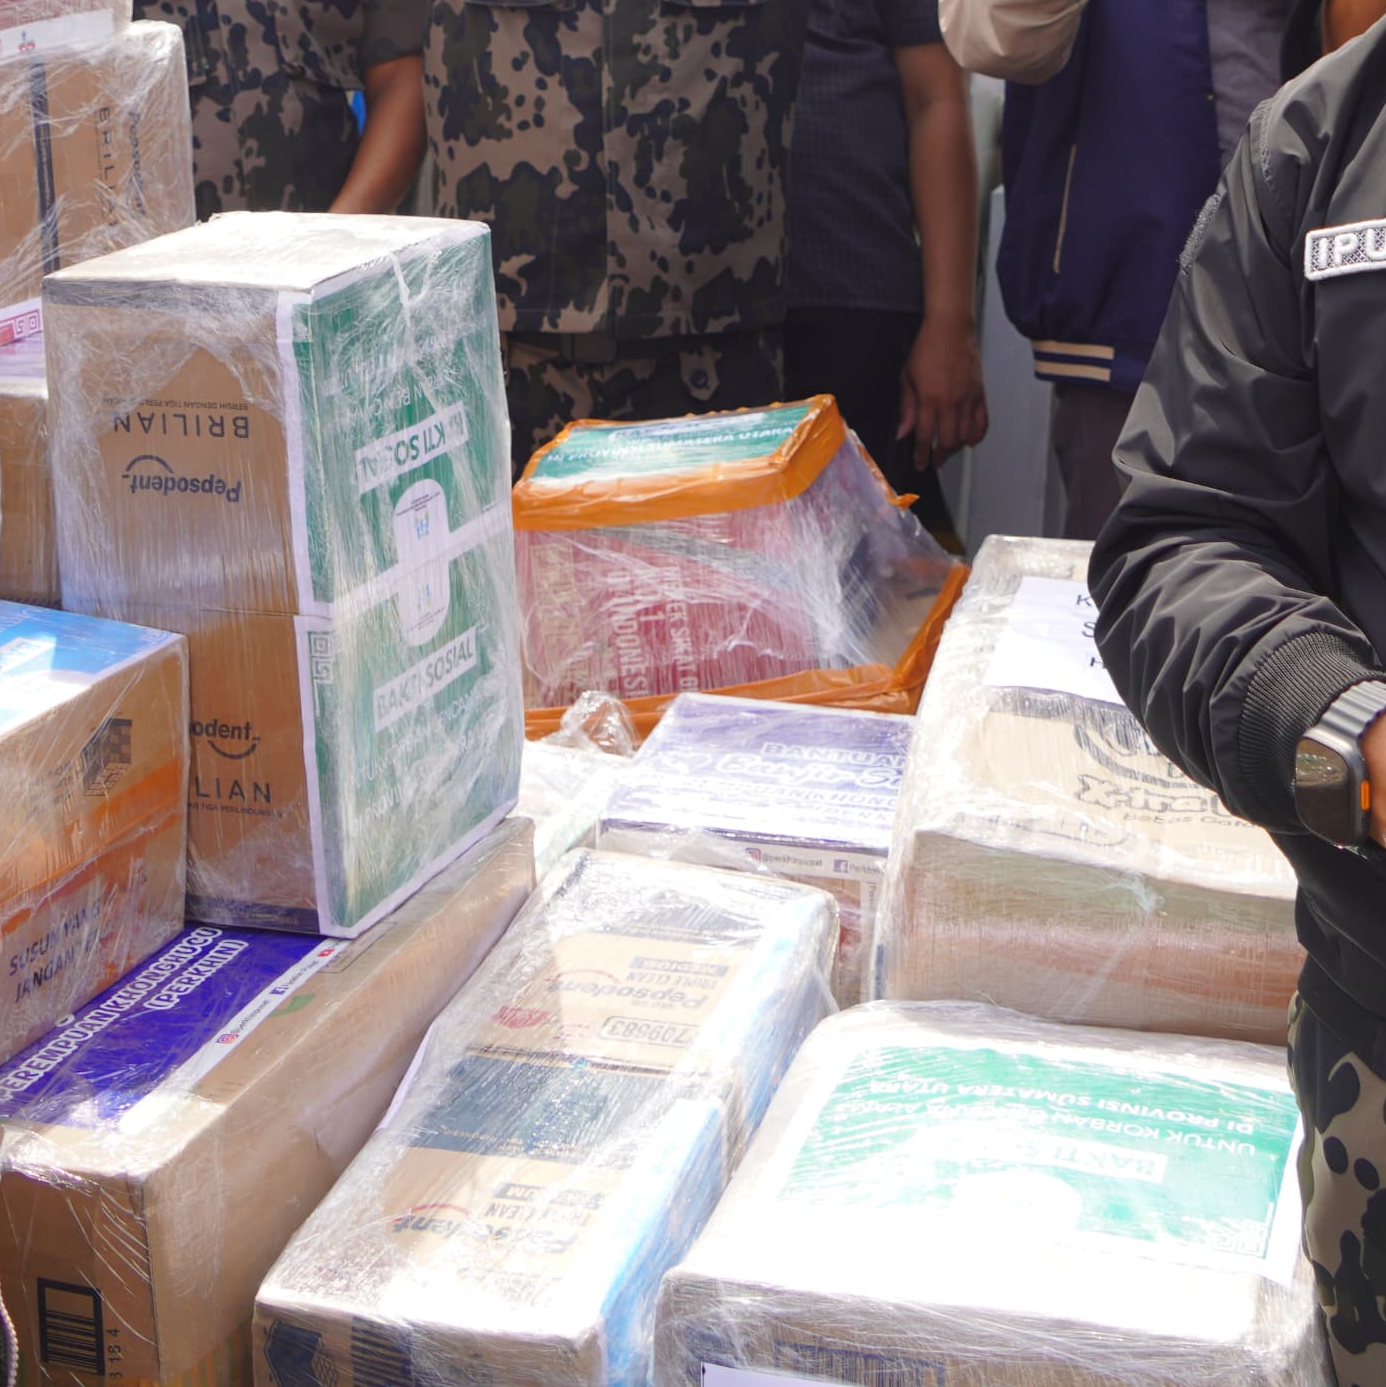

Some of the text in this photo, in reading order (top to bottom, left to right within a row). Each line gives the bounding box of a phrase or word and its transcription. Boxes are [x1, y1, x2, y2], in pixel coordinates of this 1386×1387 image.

[185, 401, 218, 410] DENGAN
[219, 401, 249, 411] BERSIH
[113, 412, 250, 439] BRILIAN
[130, 473, 243, 503] Pepsodent
[425, 635, 475, 689] SOSIAL
[195, 775, 272, 804] LIAN
[103, 927, 223, 1012] KHONGHUCU
[142, 939, 250, 1011] (PERKHIN)
[956, 1083, 1094, 1109] SUMATERA
[1097, 1100, 1221, 1128] PROVINSI
[1227, 1120, 1255, 1135] DI
[1164, 1129, 1256, 1157] UNTUK
